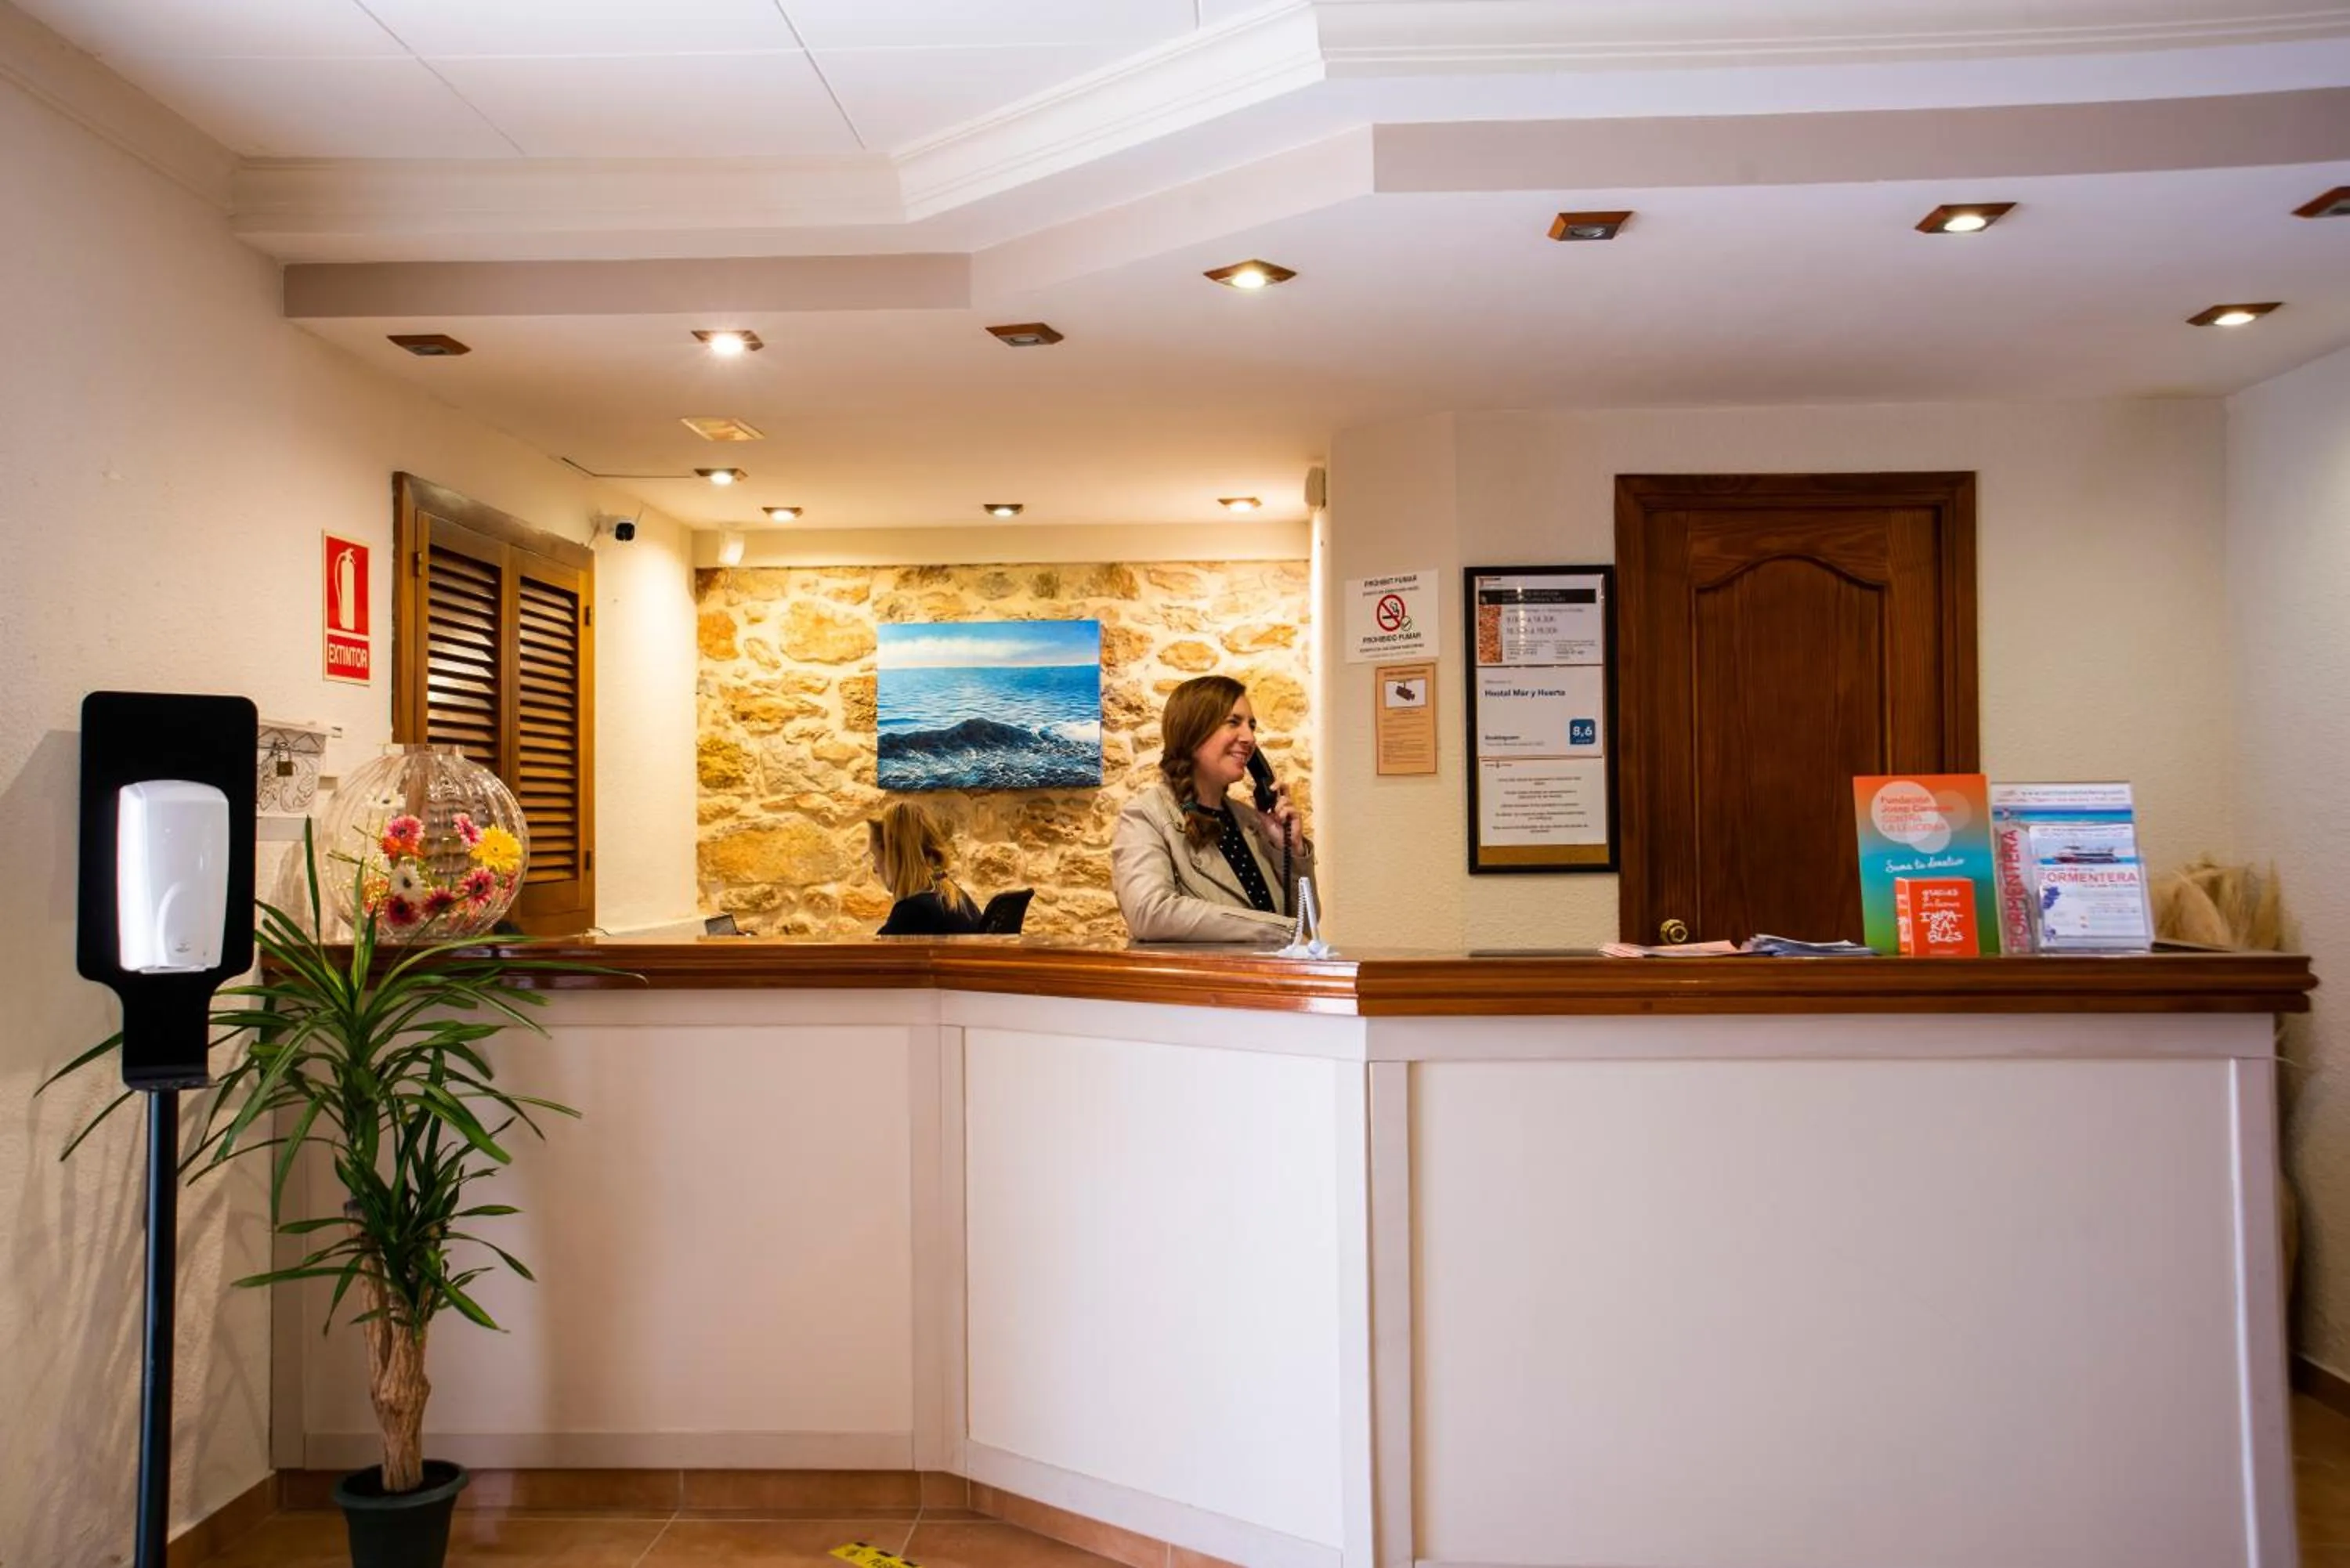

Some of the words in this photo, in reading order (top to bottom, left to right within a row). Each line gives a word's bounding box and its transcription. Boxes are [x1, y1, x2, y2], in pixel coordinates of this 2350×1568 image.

[328, 643, 367, 668] EXTINTOR
[2002, 830, 2027, 949] FORMENTERA
[2039, 872, 2137, 883] FORMENTERA
